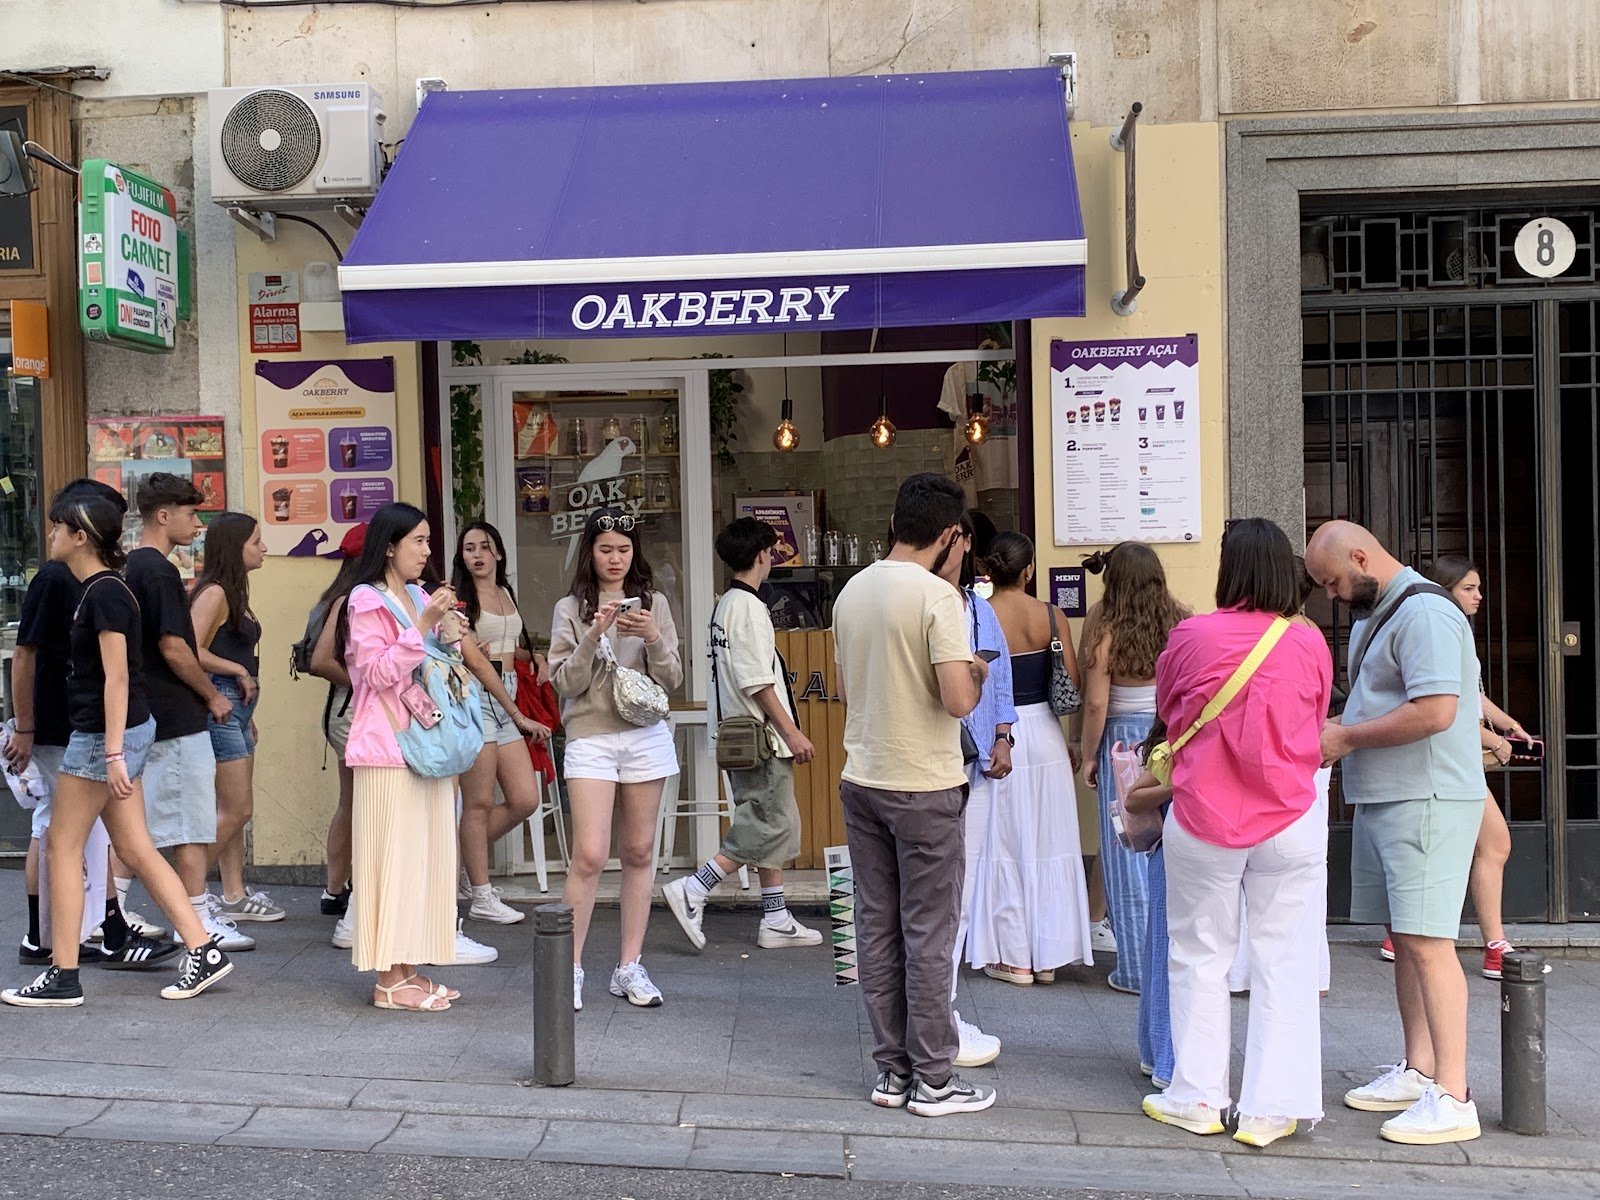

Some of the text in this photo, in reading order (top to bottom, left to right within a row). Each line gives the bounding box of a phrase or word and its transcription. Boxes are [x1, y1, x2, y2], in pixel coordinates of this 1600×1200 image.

[314, 90, 361, 100] SAMSUNG
[126, 179, 164, 210] FUJIFILM
[131, 209, 161, 243] FOTO
[0, 247, 20, 261] RIA
[121, 233, 171, 275] CARNET
[1537, 229, 1555, 266] 8
[120, 303, 133, 325] DNI
[253, 306, 297, 318] Alarma
[571, 285, 850, 331] OAKBERRY
[1071, 345, 1145, 359] OAKBERRY
[15, 357, 45, 373] orange
[1064, 377, 1075, 389] 1.
[302, 388, 350, 397] OAKBERRY
[1066, 440, 1081, 452] 2.
[1138, 437, 1149, 449] 3
[568, 478, 626, 508] OAK
[1055, 574, 1080, 582] MENU
